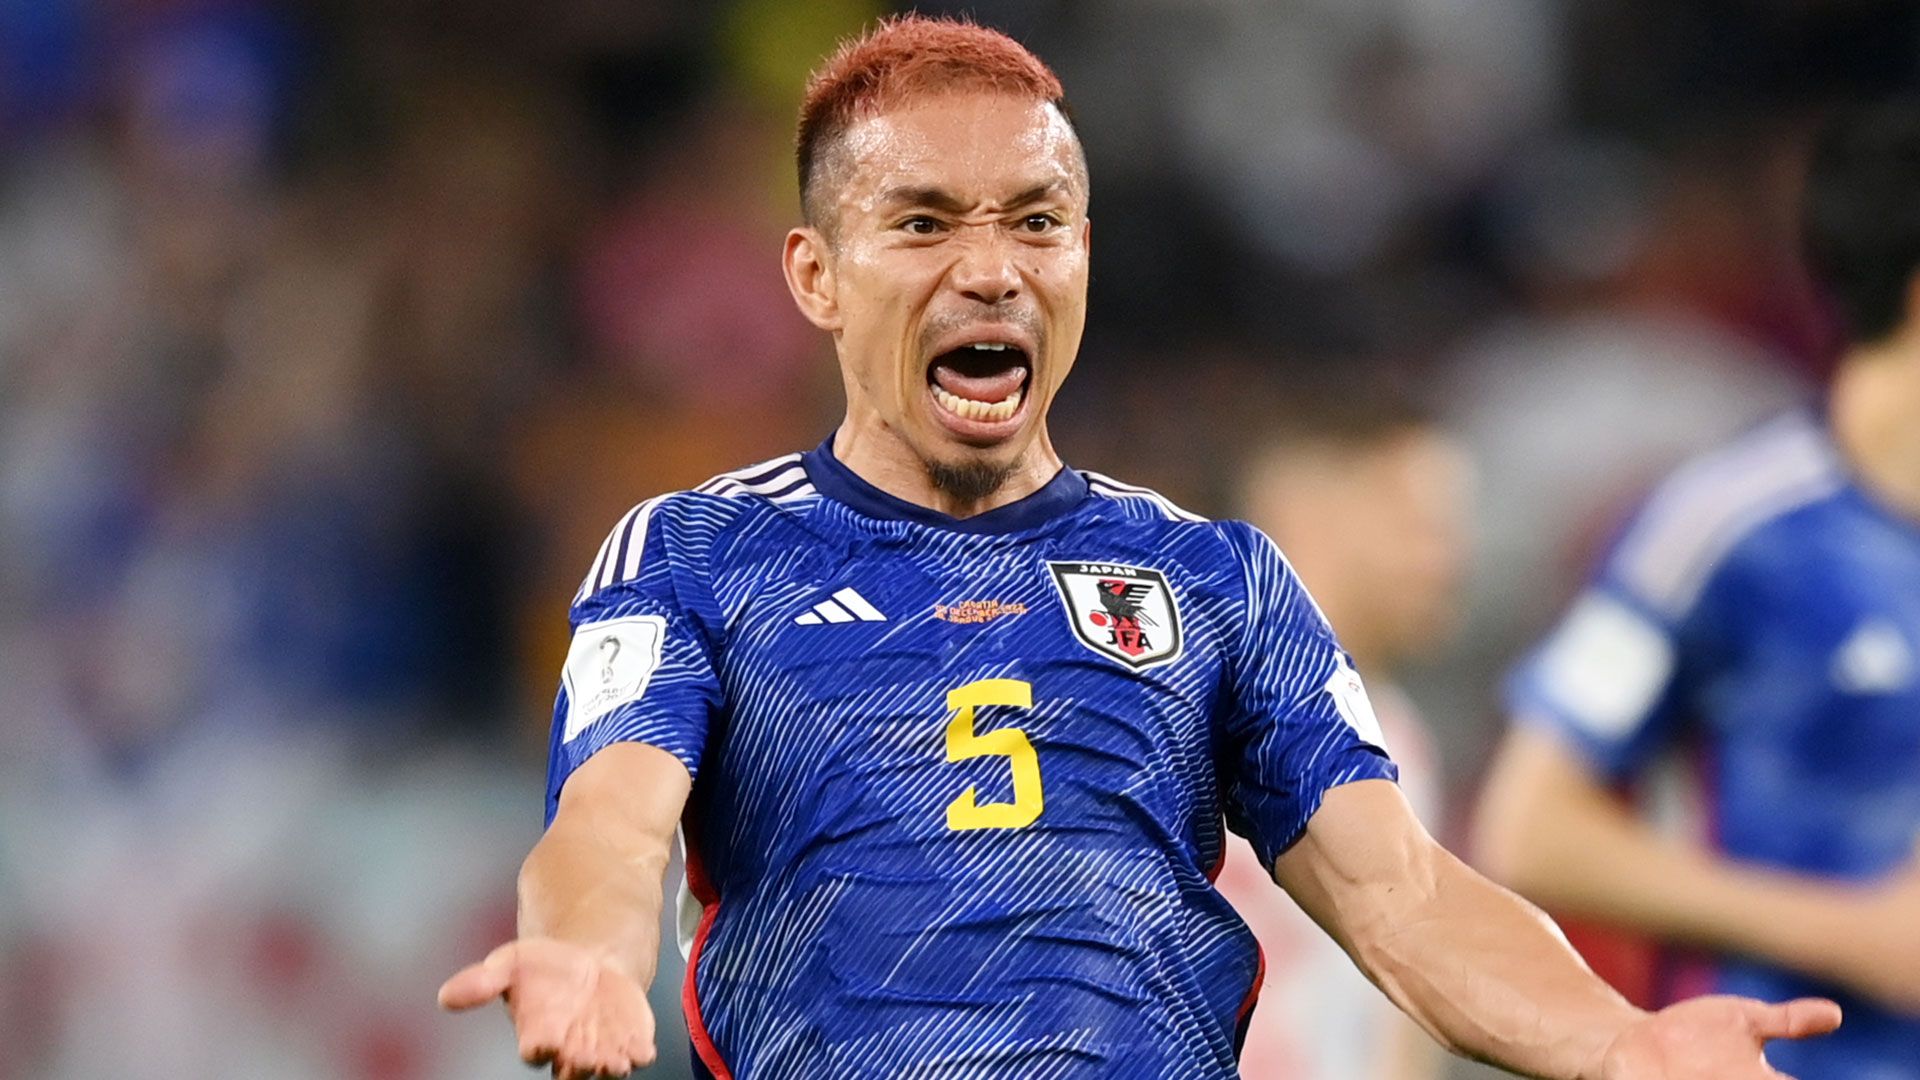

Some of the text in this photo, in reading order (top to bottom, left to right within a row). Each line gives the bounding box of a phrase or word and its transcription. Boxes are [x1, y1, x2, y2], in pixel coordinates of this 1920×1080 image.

[1079, 564, 1137, 576] JAPAN
[1106, 630, 1153, 650] JFA
[946, 678, 1045, 831] 5
